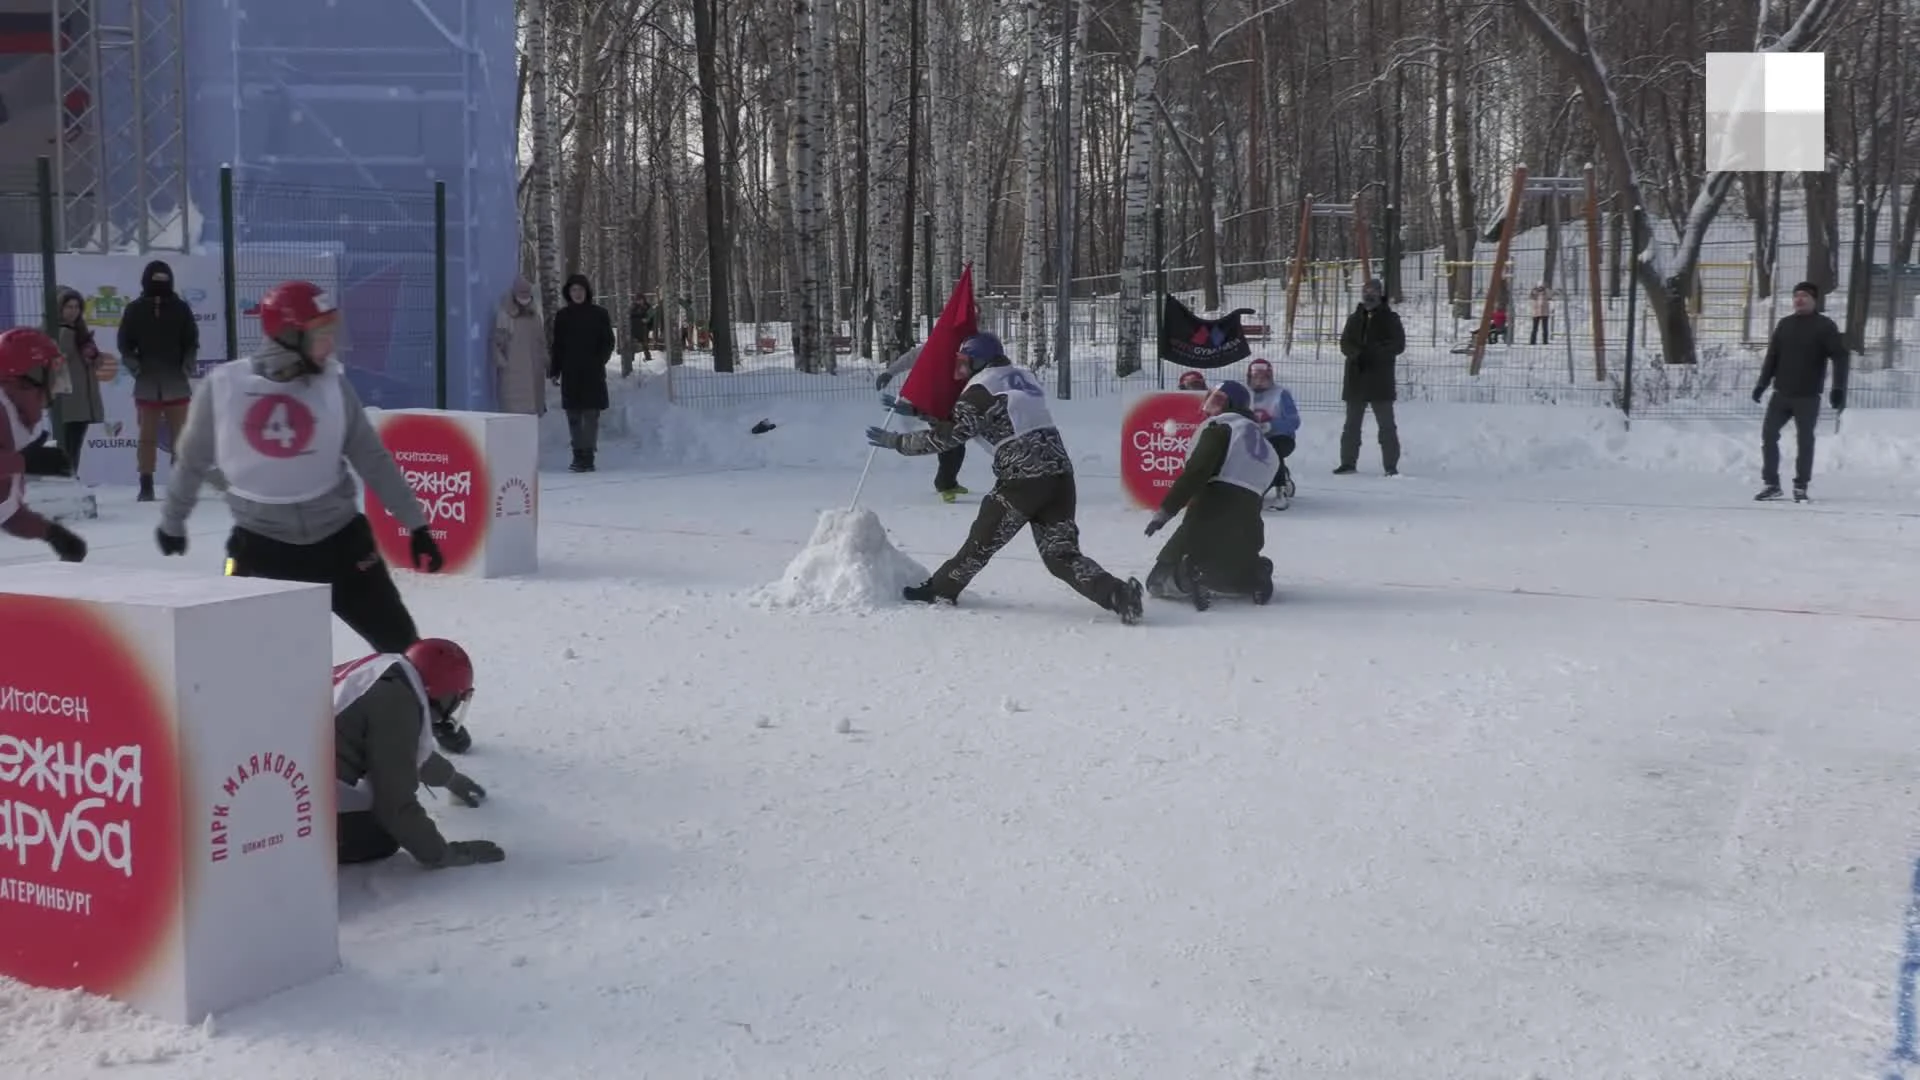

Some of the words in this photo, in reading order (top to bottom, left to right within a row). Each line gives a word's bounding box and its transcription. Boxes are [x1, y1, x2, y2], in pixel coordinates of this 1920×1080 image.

[261, 402, 298, 449] 4
[1133, 431, 1190, 453] Снеж
[401, 465, 471, 496] ежная
[211, 804, 230, 862] ПАРК
[223, 751, 312, 838] МАЯКОВСКОГО
